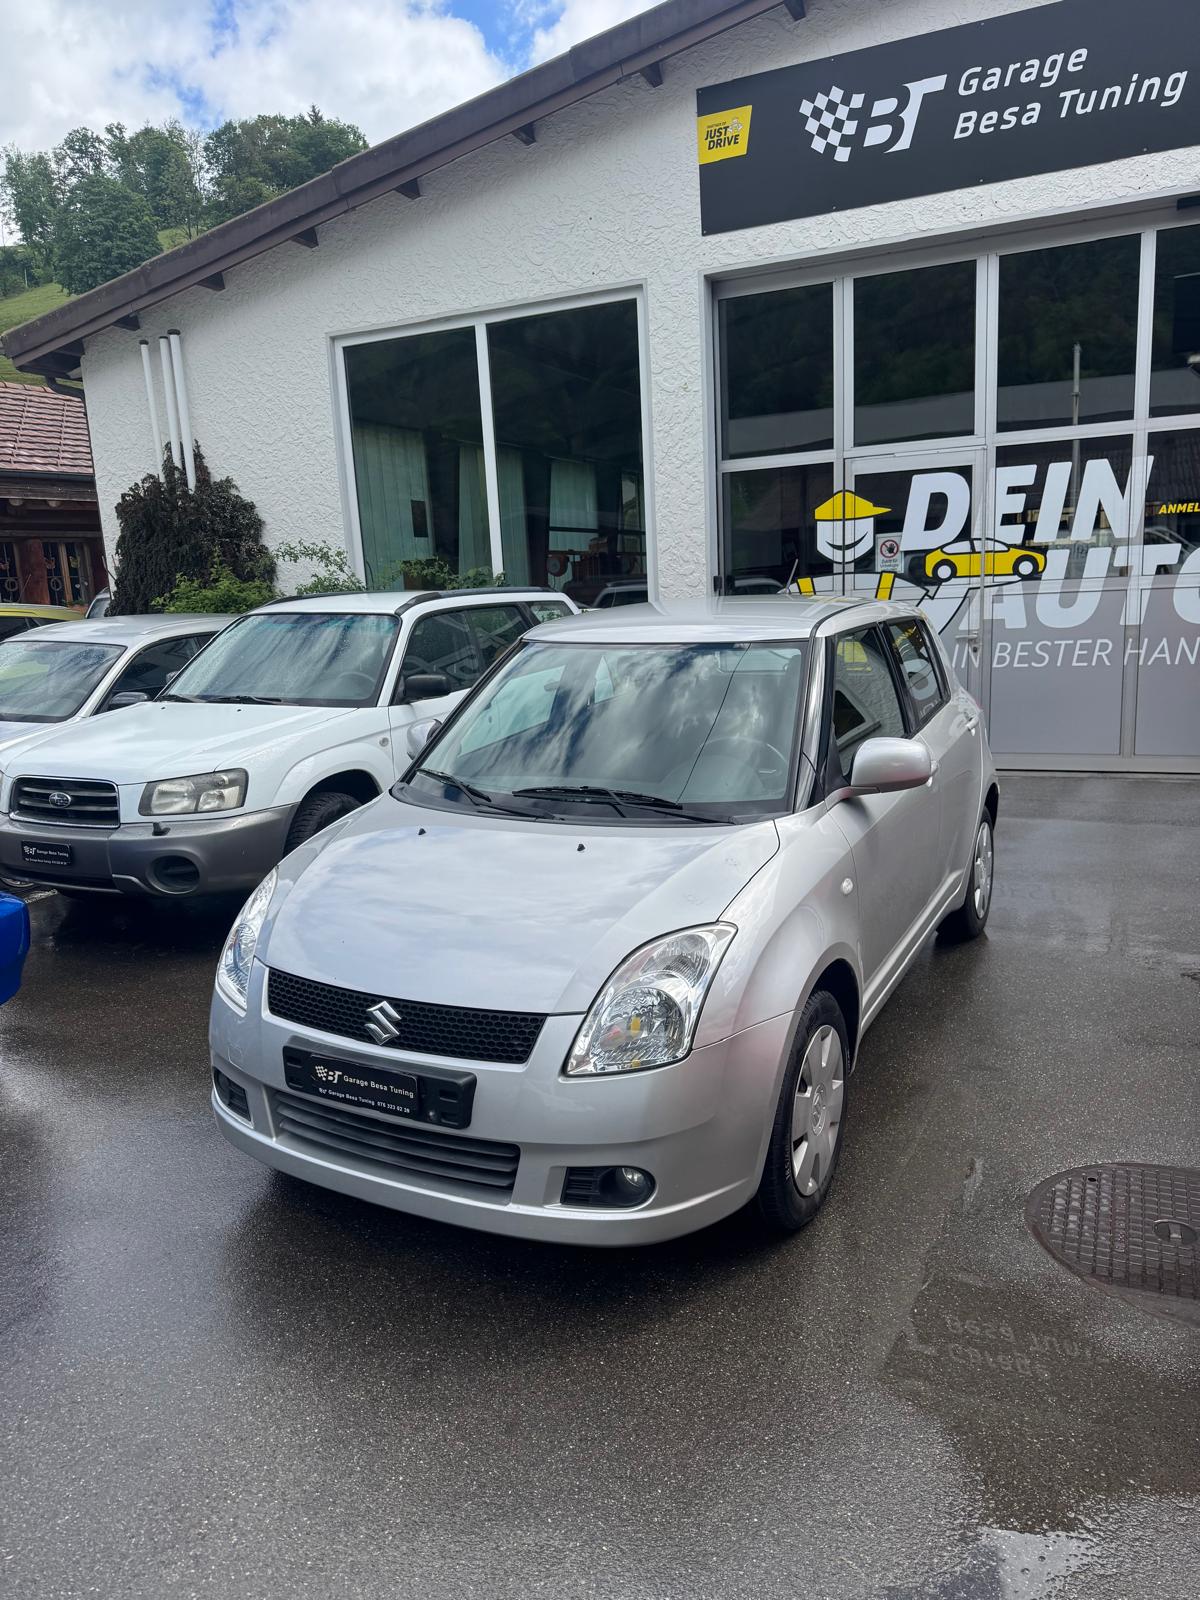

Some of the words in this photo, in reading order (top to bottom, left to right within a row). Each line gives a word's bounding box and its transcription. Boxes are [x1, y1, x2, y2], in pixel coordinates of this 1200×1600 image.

[957, 47, 1089, 96] Garage
[953, 102, 1042, 140] Besa
[1058, 70, 1188, 119] Tuning
[704, 125, 730, 141] JUST
[707, 134, 740, 151] DRIVE
[899, 455, 1155, 551] DEIN
[1158, 501, 1200, 516] ANMEL
[951, 642, 982, 669] IN
[991, 638, 1113, 668] BESTER
[1123, 636, 1200, 667] HAN
[343, 1075, 369, 1087] Garage
[370, 1081, 388, 1092] Besa
[389, 1085, 414, 1099] Tuning
